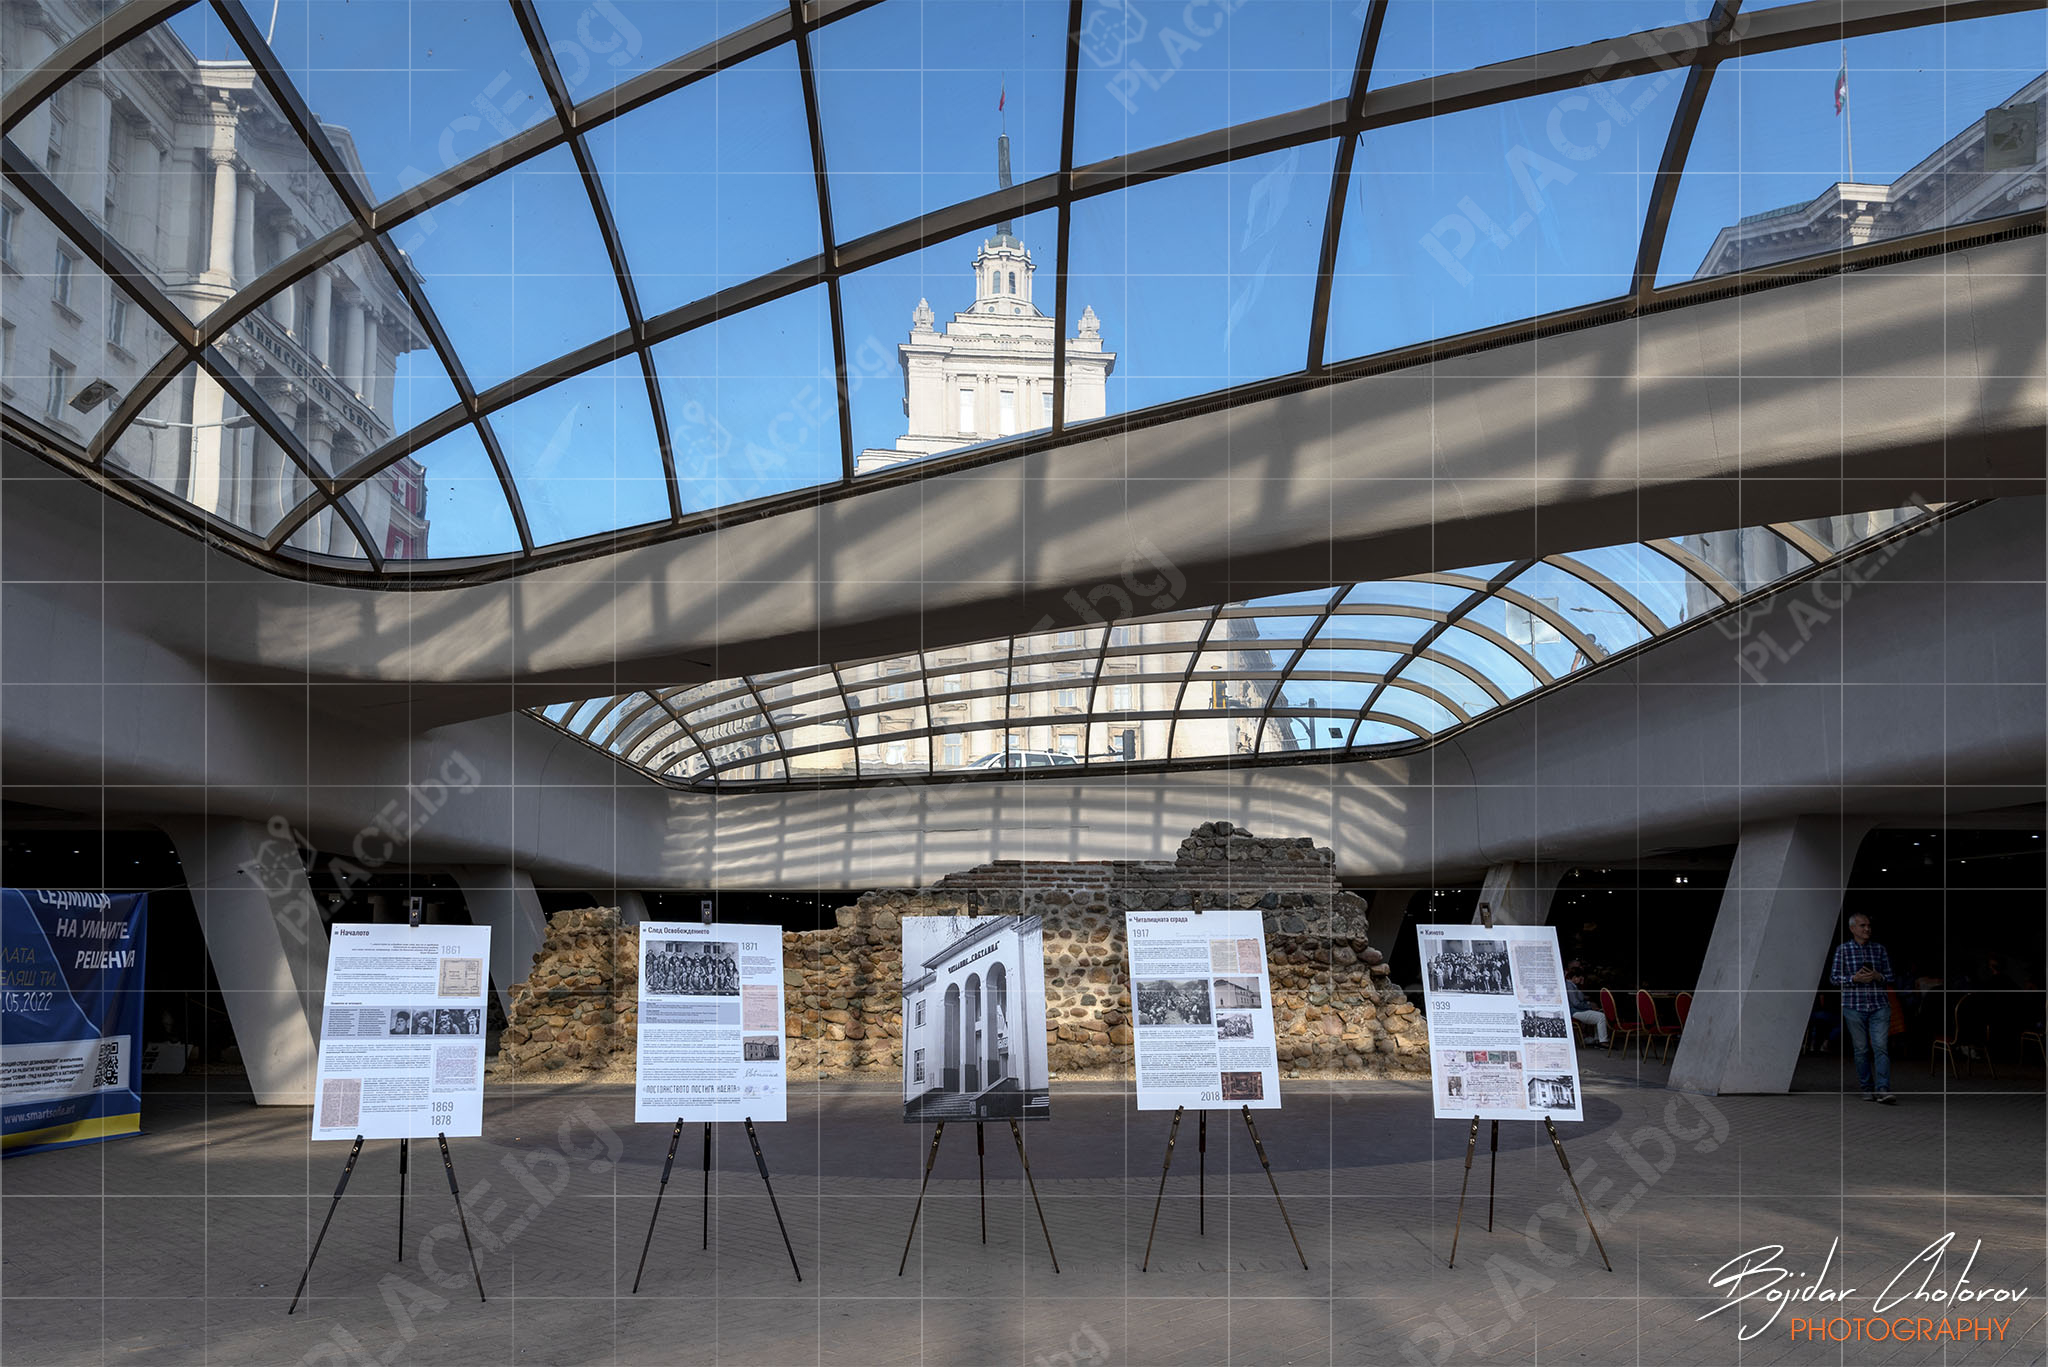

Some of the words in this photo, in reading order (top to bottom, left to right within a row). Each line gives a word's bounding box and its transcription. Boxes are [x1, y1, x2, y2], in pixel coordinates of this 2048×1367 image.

[244, 315, 331, 400] МИНИСТЕРСКИ
[342, 404, 374, 440] СЪВЕТ
[36, 889, 111, 913] СЕДМИЦА
[1133, 915, 1170, 923] Читалищната
[1171, 916, 1189, 924] сграда
[55, 917, 78, 937] НА
[80, 919, 130, 940] УМНИТЕ
[340, 928, 370, 937] Началото
[648, 927, 663, 935] След
[663, 927, 710, 936] Освобождението
[1133, 929, 1149, 938] 1917
[441, 945, 462, 955] 1861
[741, 942, 758, 951] 1871
[74, 949, 136, 969] РЕШЕНИЯ
[1432, 1001, 1451, 1010] 1939
[1200, 1091, 1220, 1101] 2018
[431, 1101, 454, 1112] 1869
[431, 1115, 452, 1126] 1878
